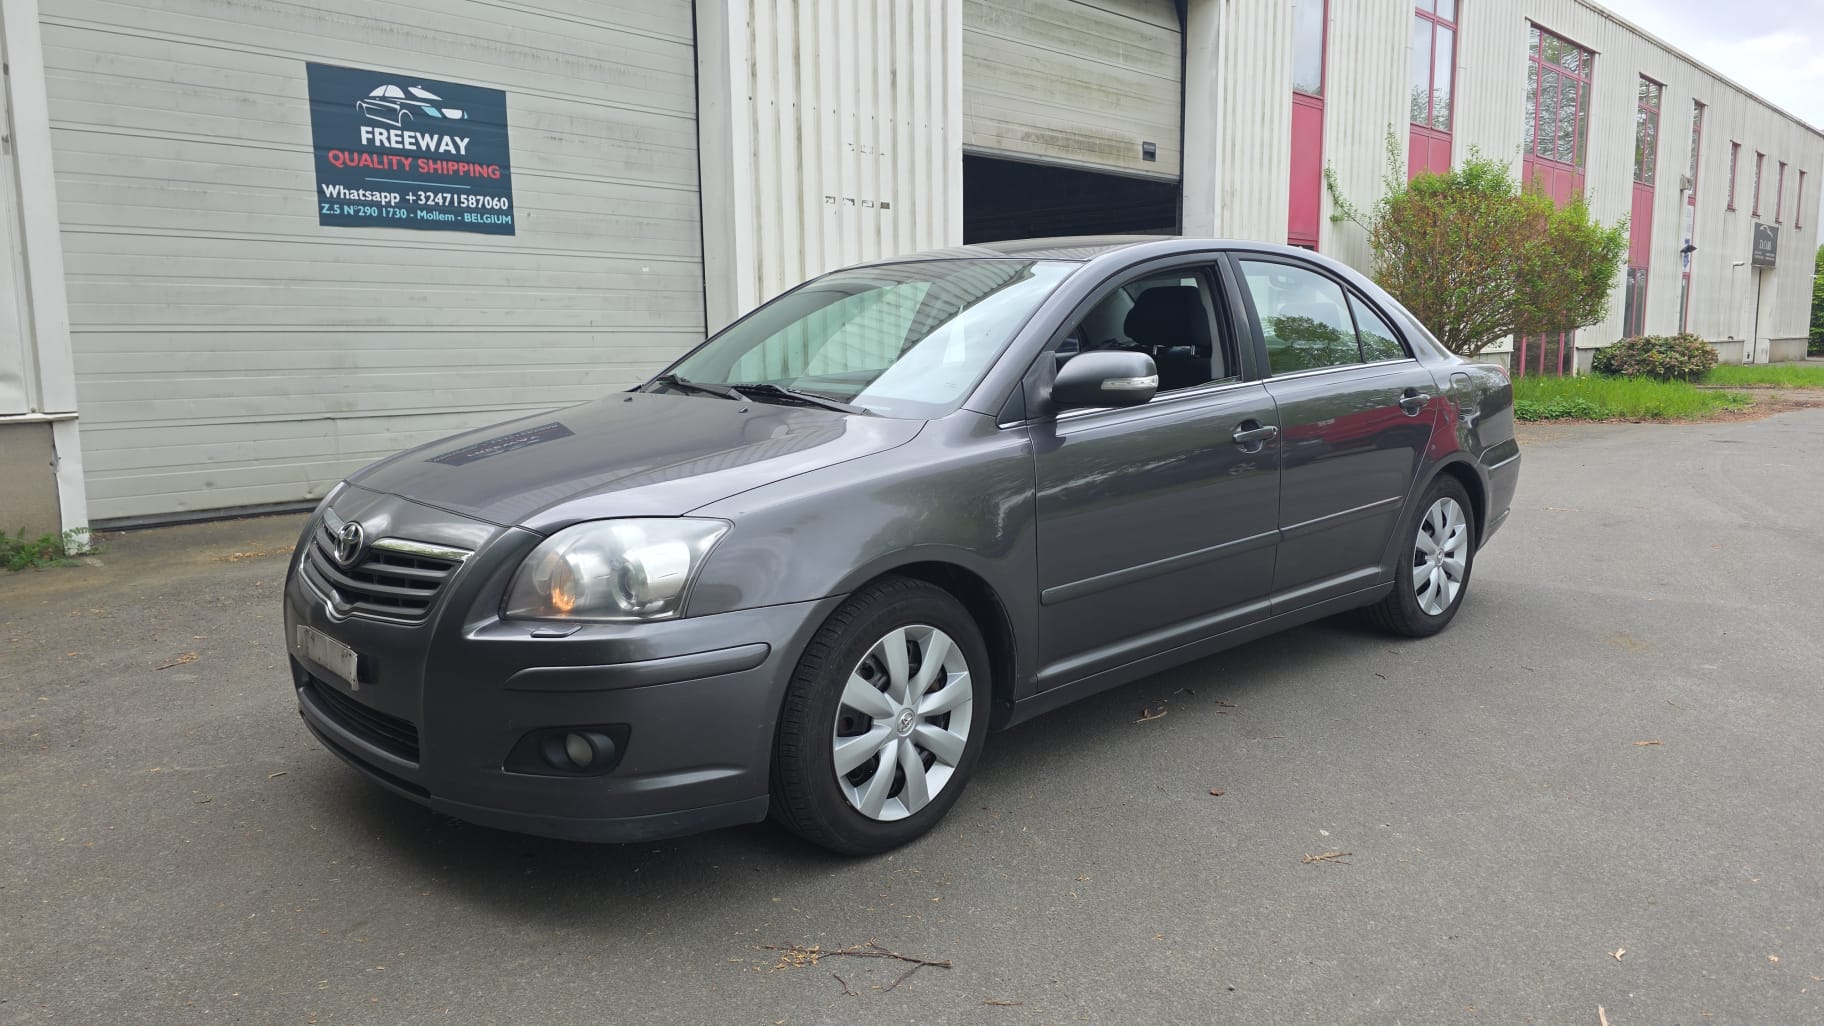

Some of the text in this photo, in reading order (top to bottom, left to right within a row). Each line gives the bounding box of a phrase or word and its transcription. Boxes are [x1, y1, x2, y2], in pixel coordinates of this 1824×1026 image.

[360, 125, 470, 155] FREEWAY
[328, 149, 500, 180] QUALITY SHIPPING
[321, 184, 509, 210] Whatsapp +32471587060
[321, 203, 341, 214] Z.5
[382, 207, 407, 218] 1730
[416, 209, 455, 221] Mollem
[463, 212, 512, 225] BELGIUM
